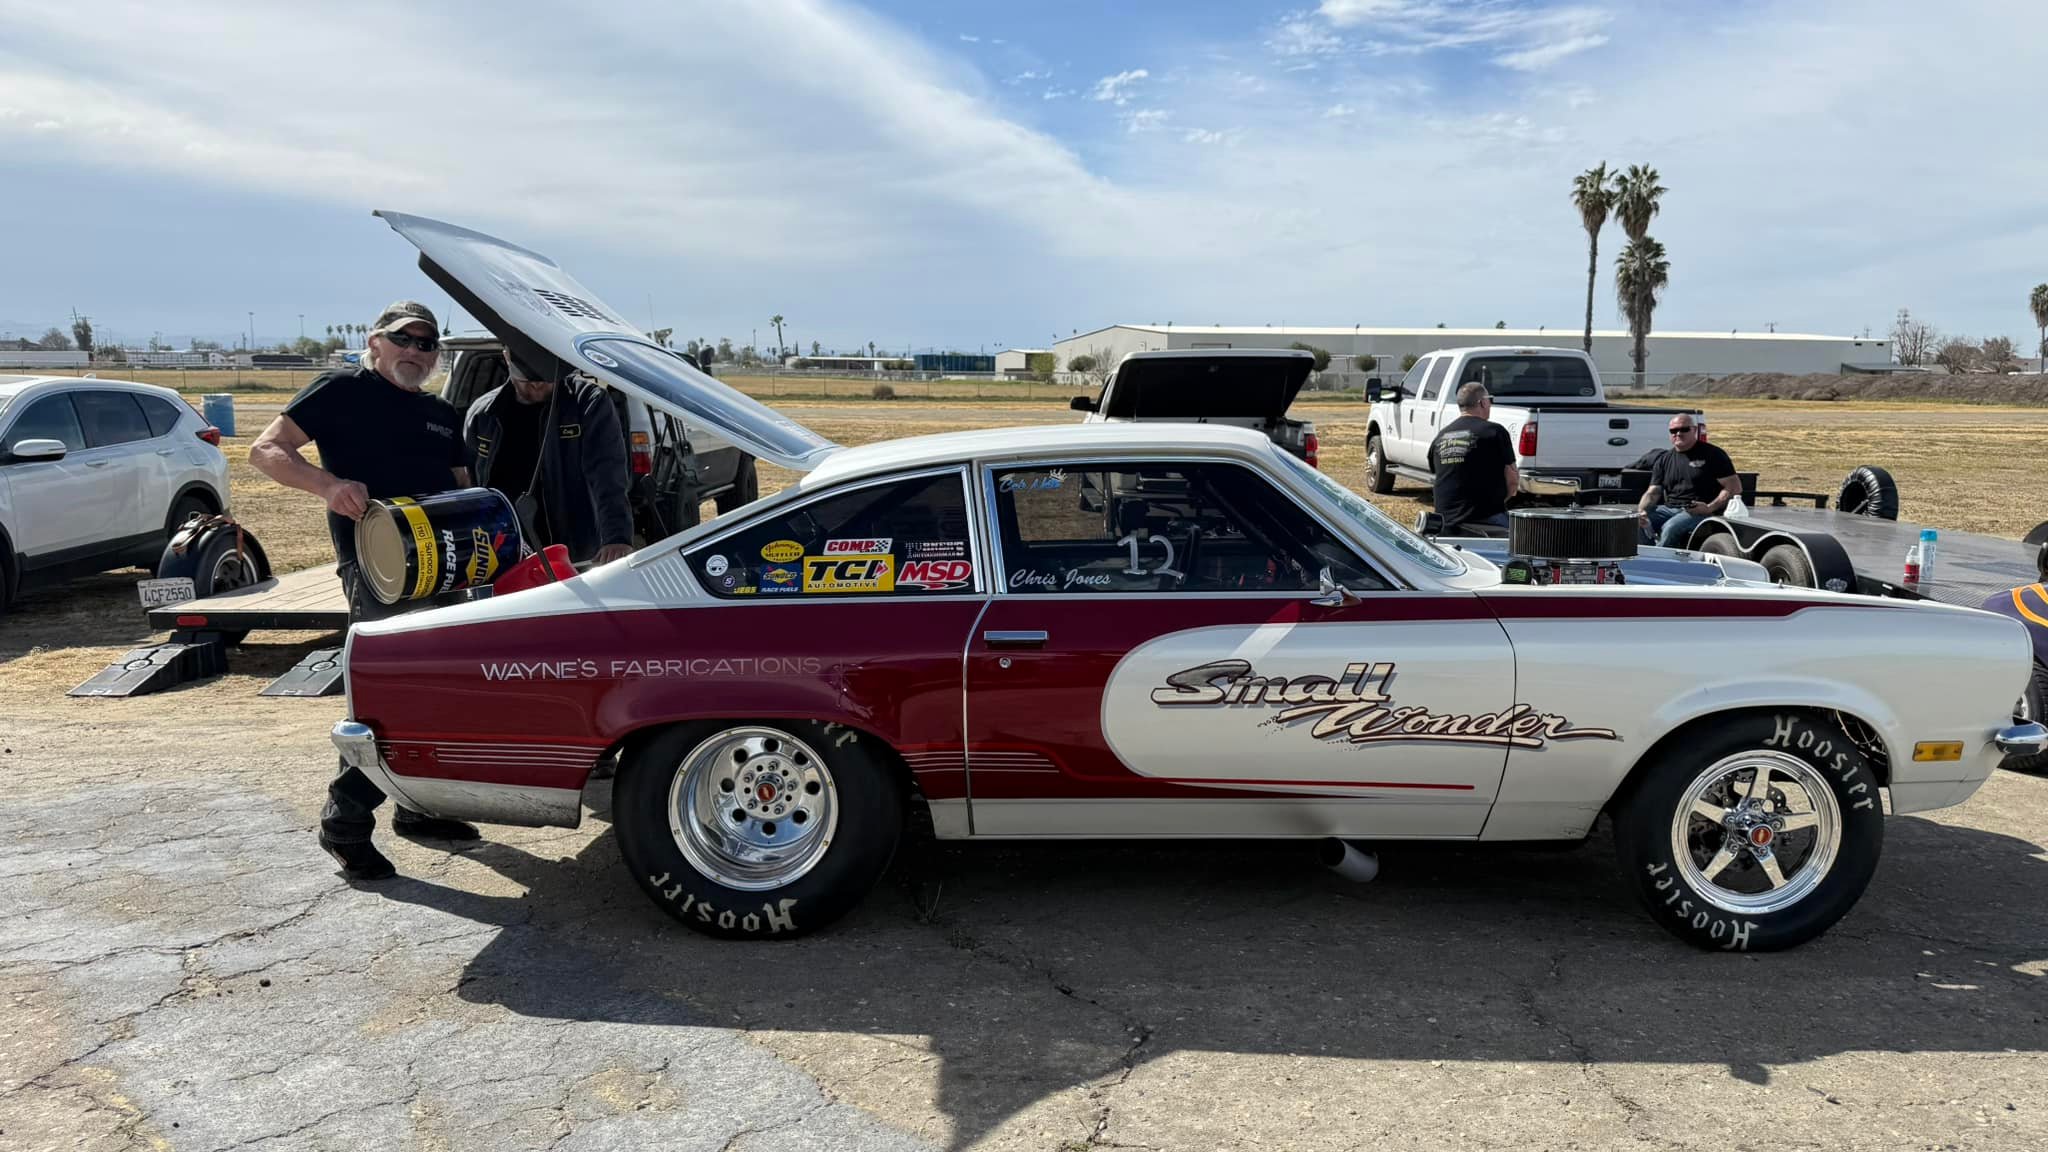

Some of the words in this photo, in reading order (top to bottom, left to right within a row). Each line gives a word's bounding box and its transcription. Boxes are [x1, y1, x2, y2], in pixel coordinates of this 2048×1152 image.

[425, 542, 433, 575] Sunoco
[441, 529, 457, 570] RACE
[473, 531, 490, 586] SUNOC
[827, 541, 876, 552] COMP
[440, 572, 455, 593] FUE
[808, 560, 883, 581] TCI
[898, 560, 972, 583] MSD
[1009, 568, 1057, 588] Chris
[1063, 568, 1112, 590] Jones
[480, 658, 598, 681] WAYNE'S
[611, 656, 822, 678] FABRICATIONS
[1150, 659, 1396, 705] Small
[1275, 701, 1617, 742] Wonder
